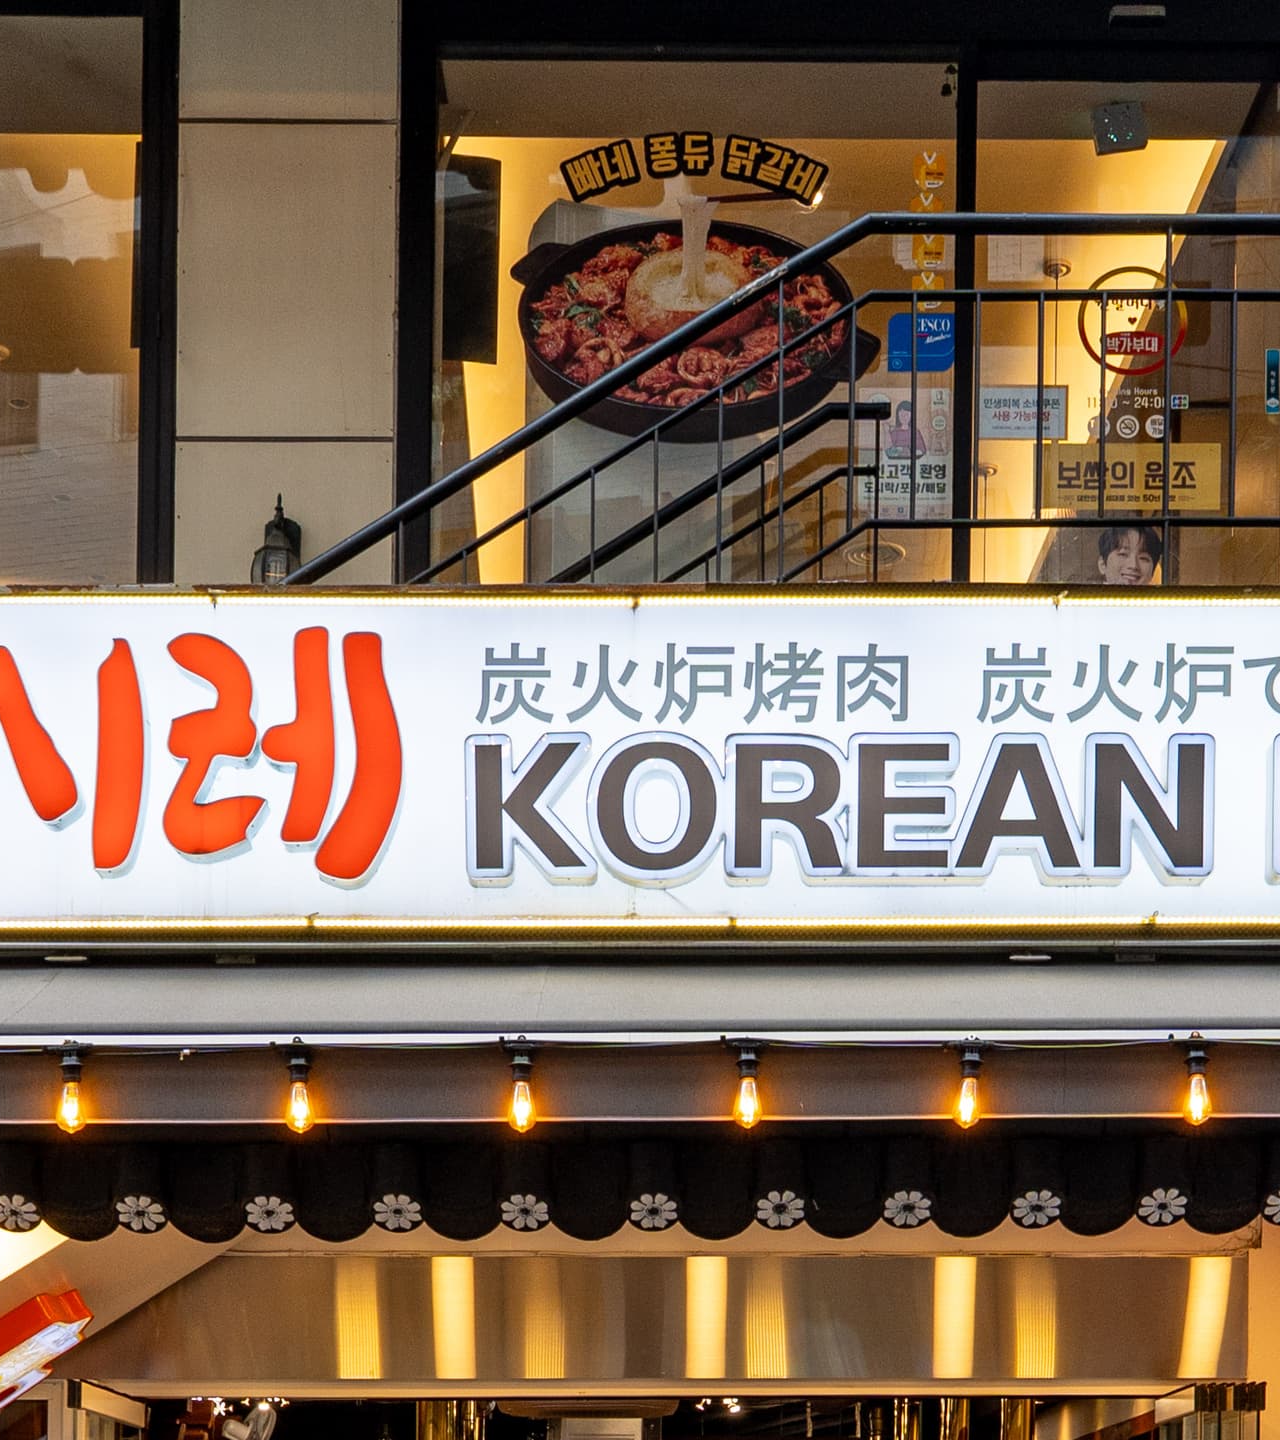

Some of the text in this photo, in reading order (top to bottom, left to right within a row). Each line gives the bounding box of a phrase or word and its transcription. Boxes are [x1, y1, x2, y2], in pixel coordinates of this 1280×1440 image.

[566, 134, 825, 200] 빠네 퐁듀 닭갈비
[1107, 336, 1158, 353] 박가부대
[920, 464, 946, 480] 환영
[475, 642, 909, 724] 炭火炉烤肉
[470, 738, 1210, 876] KOREAN
